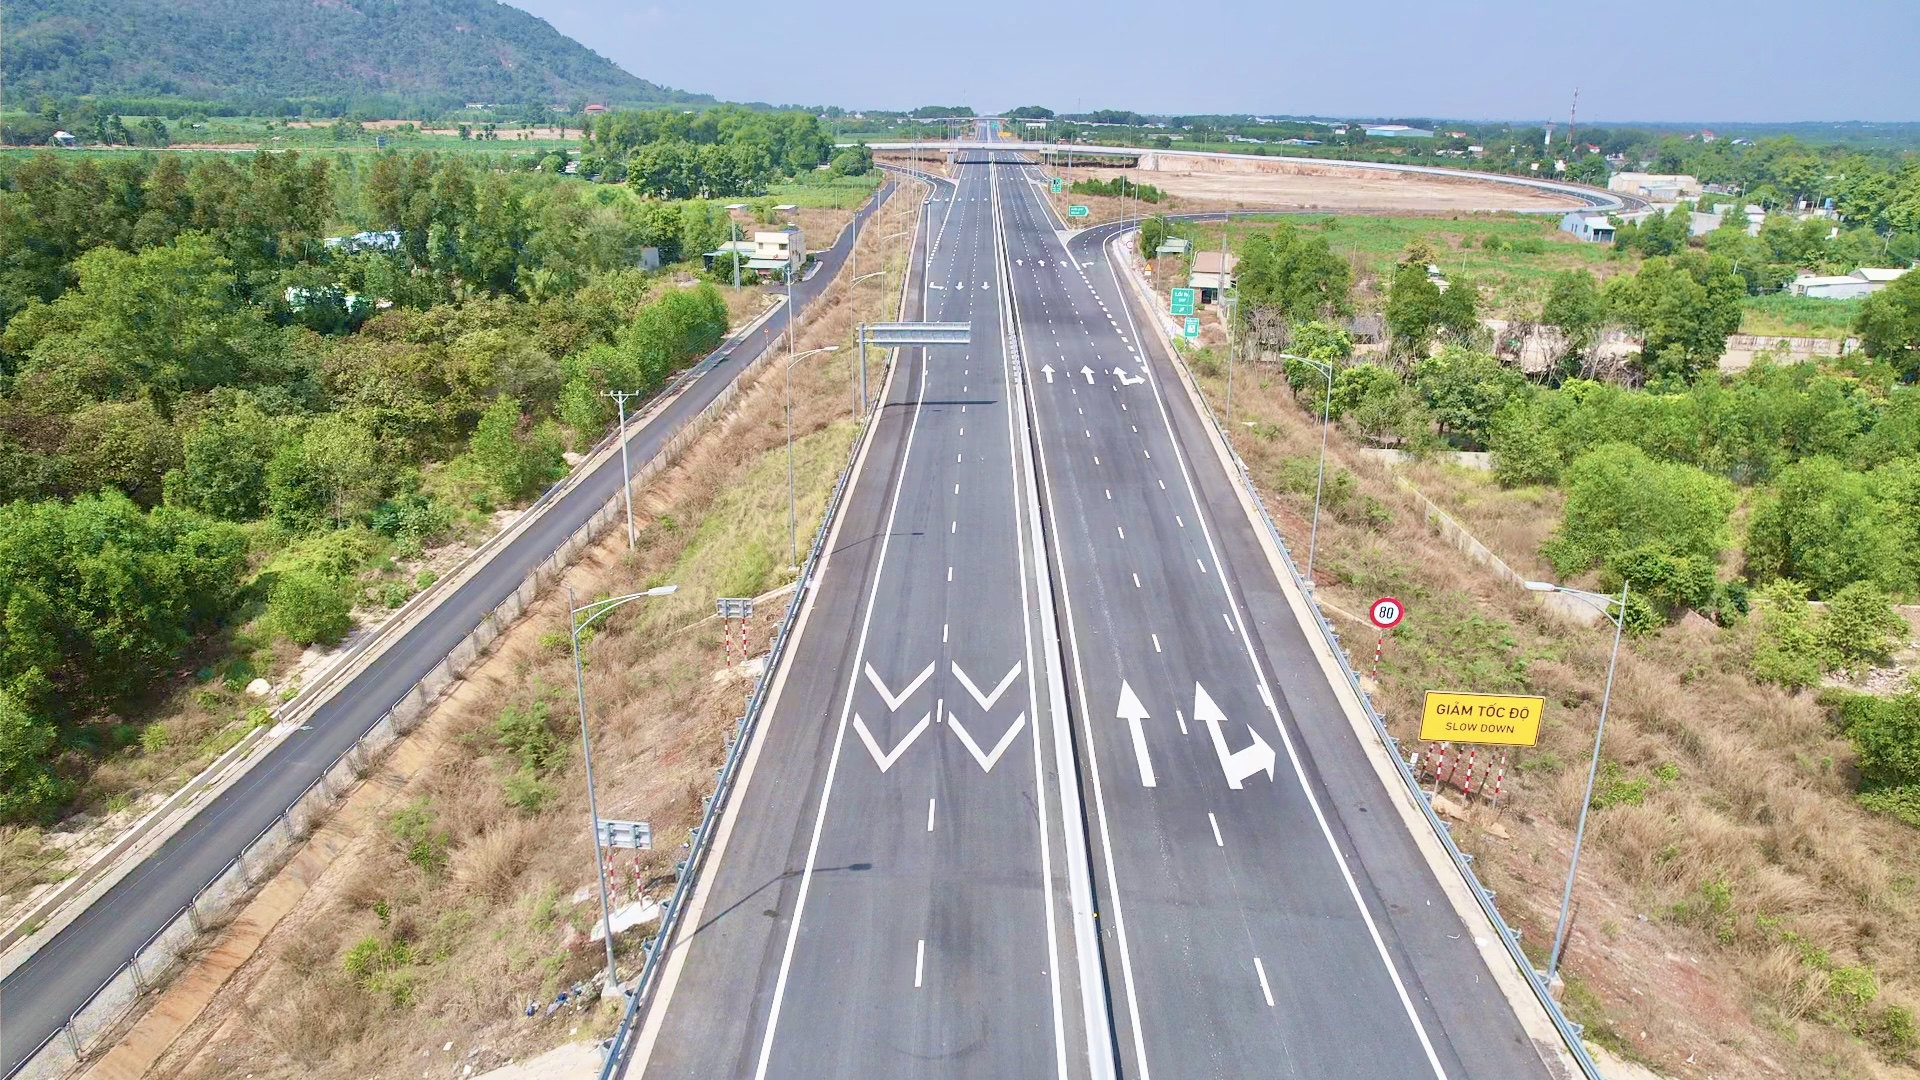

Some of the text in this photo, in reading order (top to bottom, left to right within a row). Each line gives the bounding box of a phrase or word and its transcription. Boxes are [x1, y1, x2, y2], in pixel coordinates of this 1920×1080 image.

[1379, 606, 1394, 619] 80
[1436, 701, 1530, 721] GIẢM TỐC ĐỘ
[1445, 722, 1515, 734] SLOW DOWN
